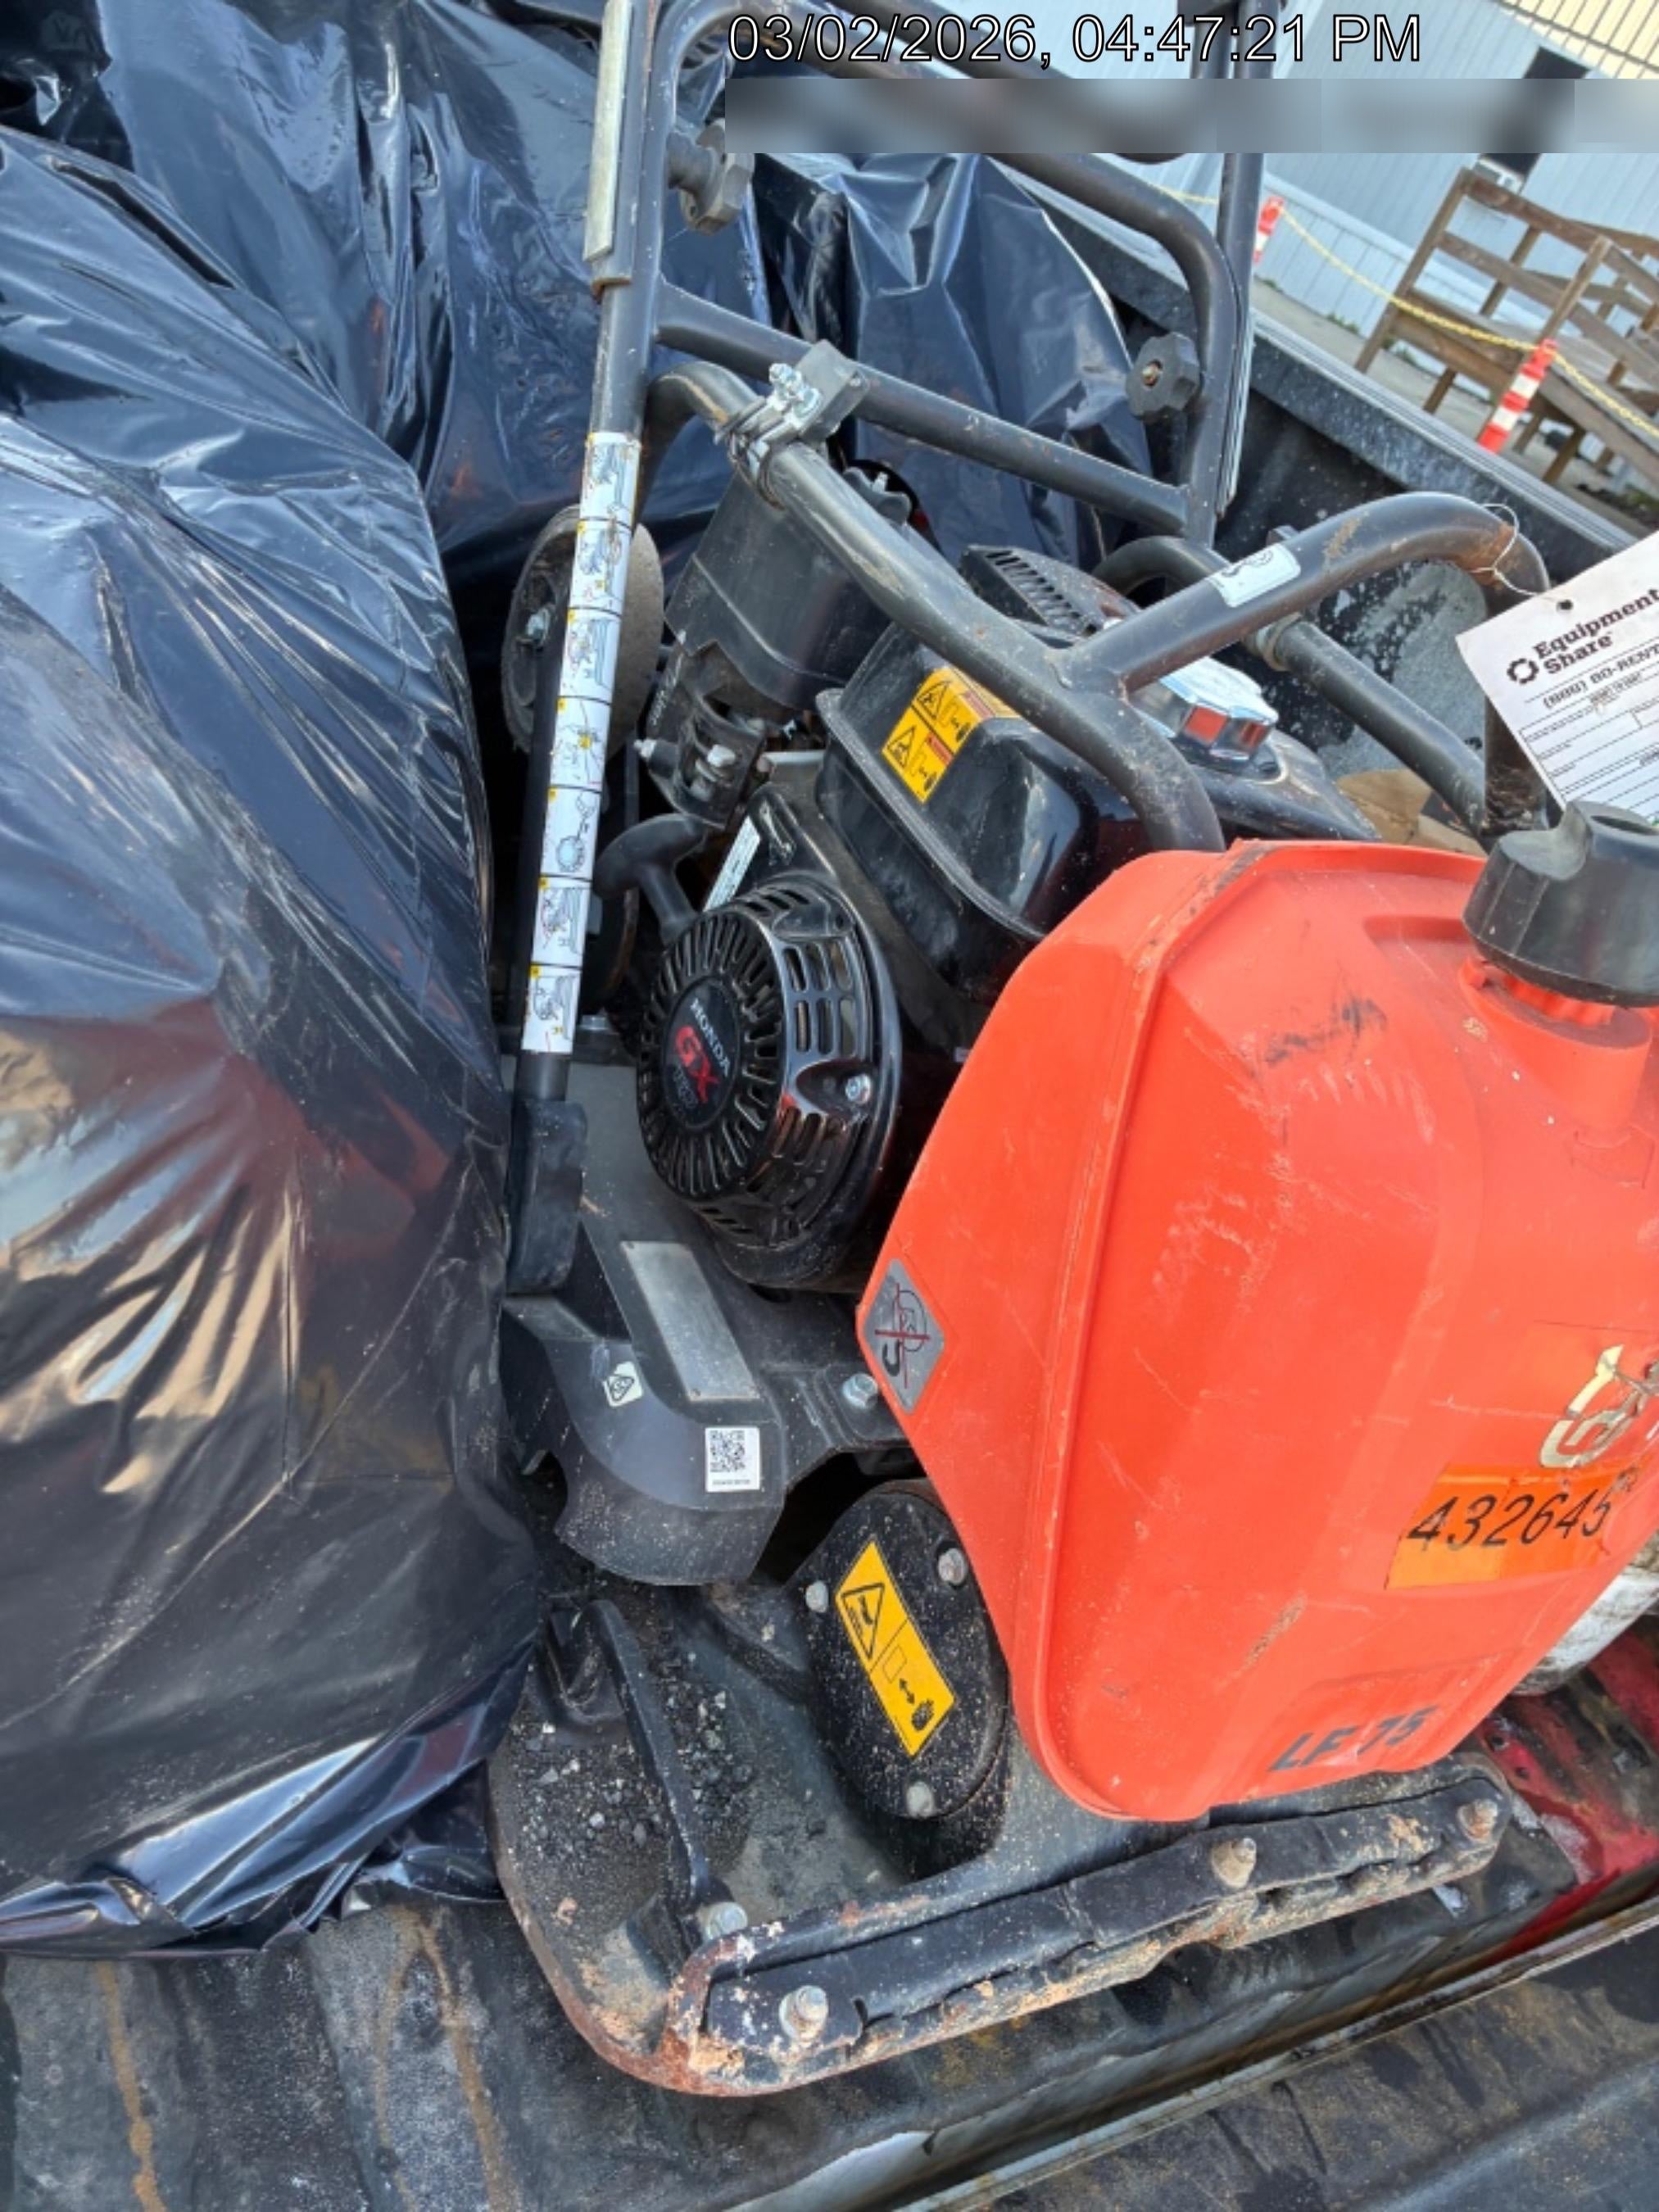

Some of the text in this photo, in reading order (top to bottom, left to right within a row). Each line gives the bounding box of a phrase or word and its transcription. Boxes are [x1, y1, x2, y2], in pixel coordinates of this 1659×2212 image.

[1533, 588, 1659, 660] Equipment
[1543, 635, 1613, 674] Share
[676, 1027, 720, 1103] GX
[691, 998, 730, 1077] HONDA
[1406, 1488, 1612, 1552] 432645
[1267, 1704, 1439, 1772] LF 75
